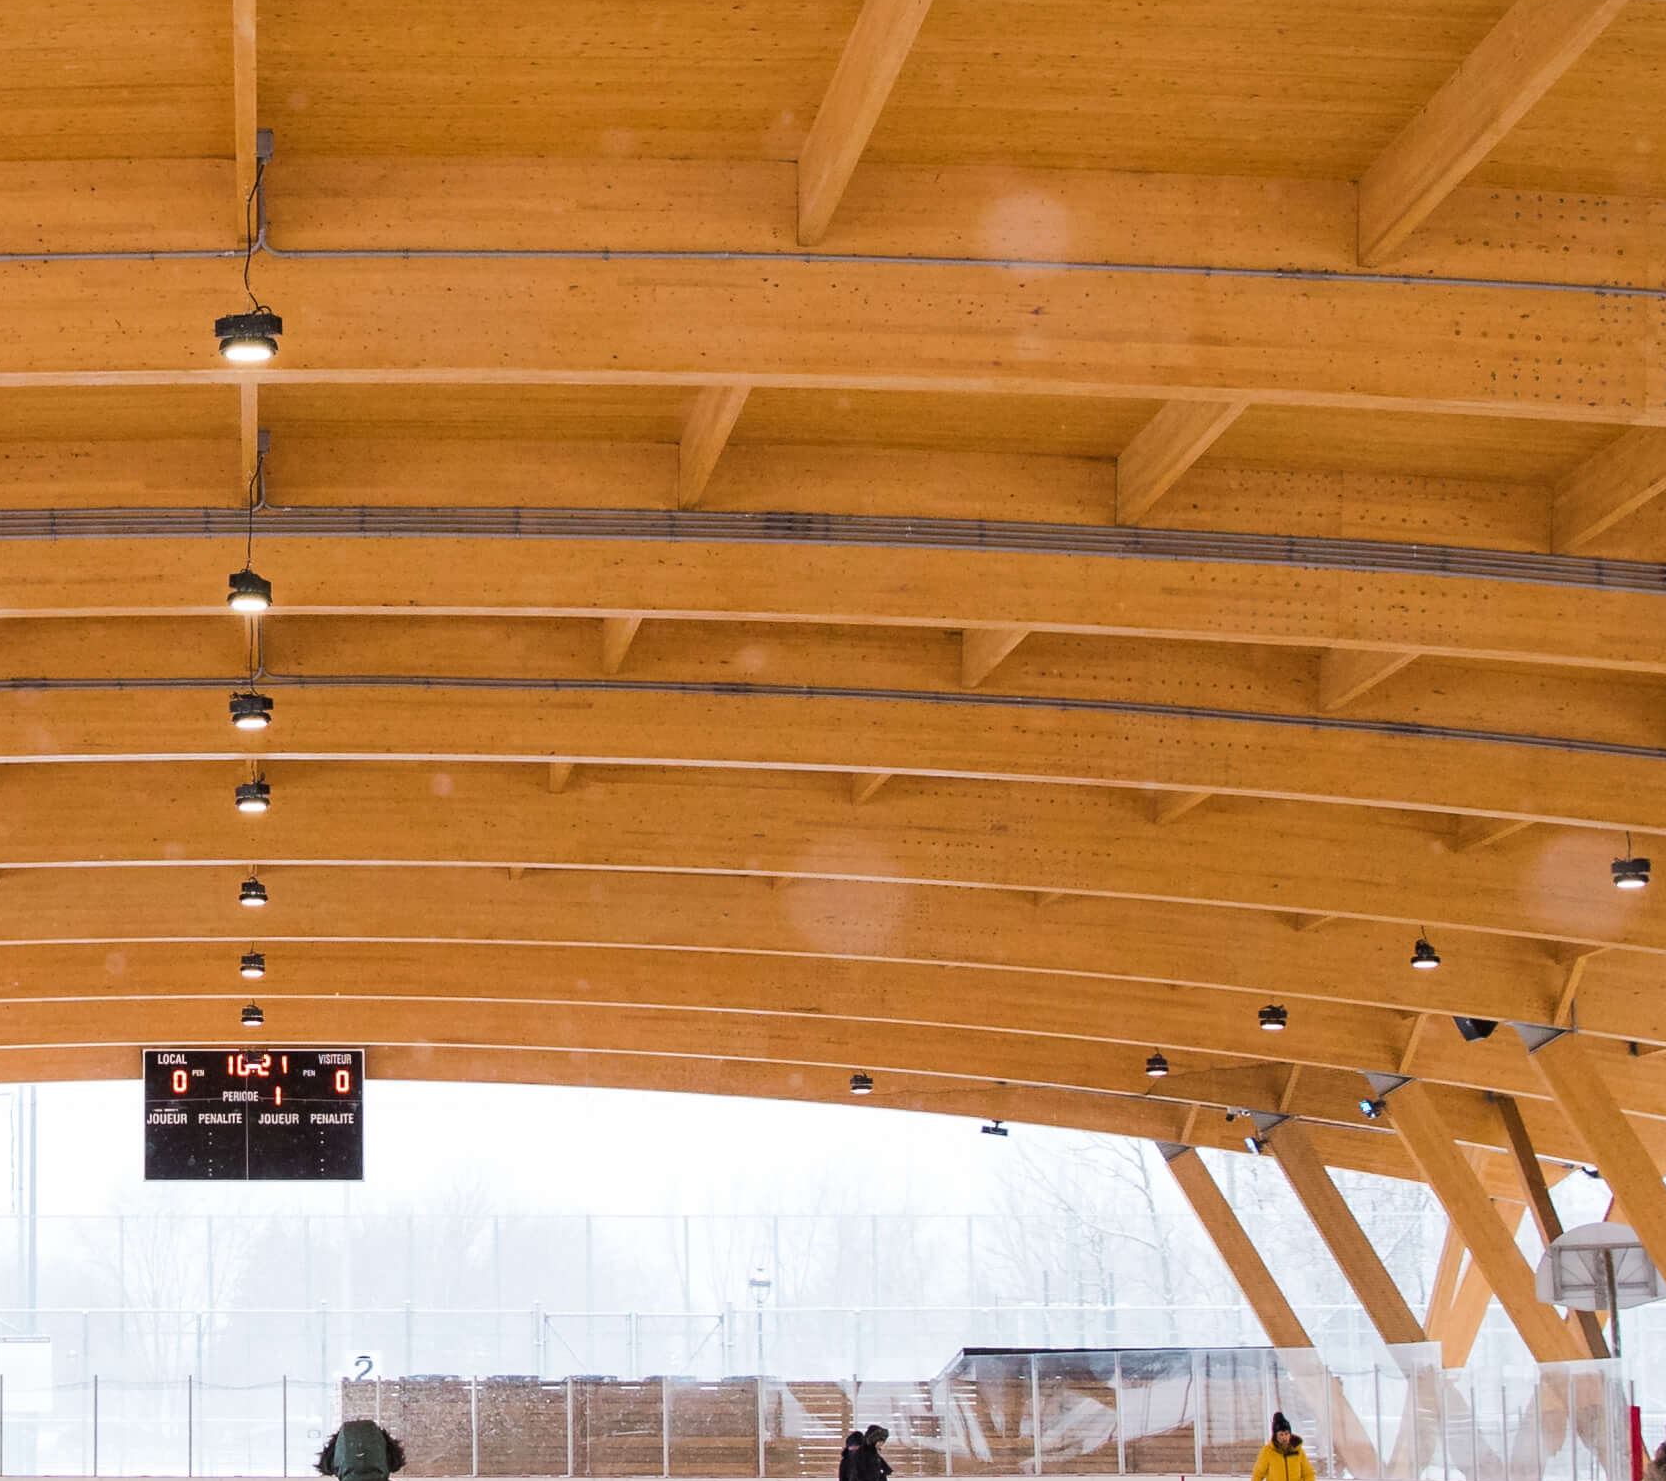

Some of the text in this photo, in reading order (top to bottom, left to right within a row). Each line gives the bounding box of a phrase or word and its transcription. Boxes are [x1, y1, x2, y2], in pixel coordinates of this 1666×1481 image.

[157, 1053, 188, 1065] LOCAL
[318, 1053, 352, 1065] VISITEUR
[191, 1069, 205, 1077] PEN
[302, 1069, 316, 1077] PEN
[172, 1069, 187, 1093] 0
[335, 1069, 350, 1093] 0
[222, 1085, 282, 1106] PERIODE 1
[146, 1113, 243, 1125] JOUEUR PENALITE
[258, 1113, 355, 1125] JOUEUR PENALITE
[354, 1355, 374, 1382] 2
